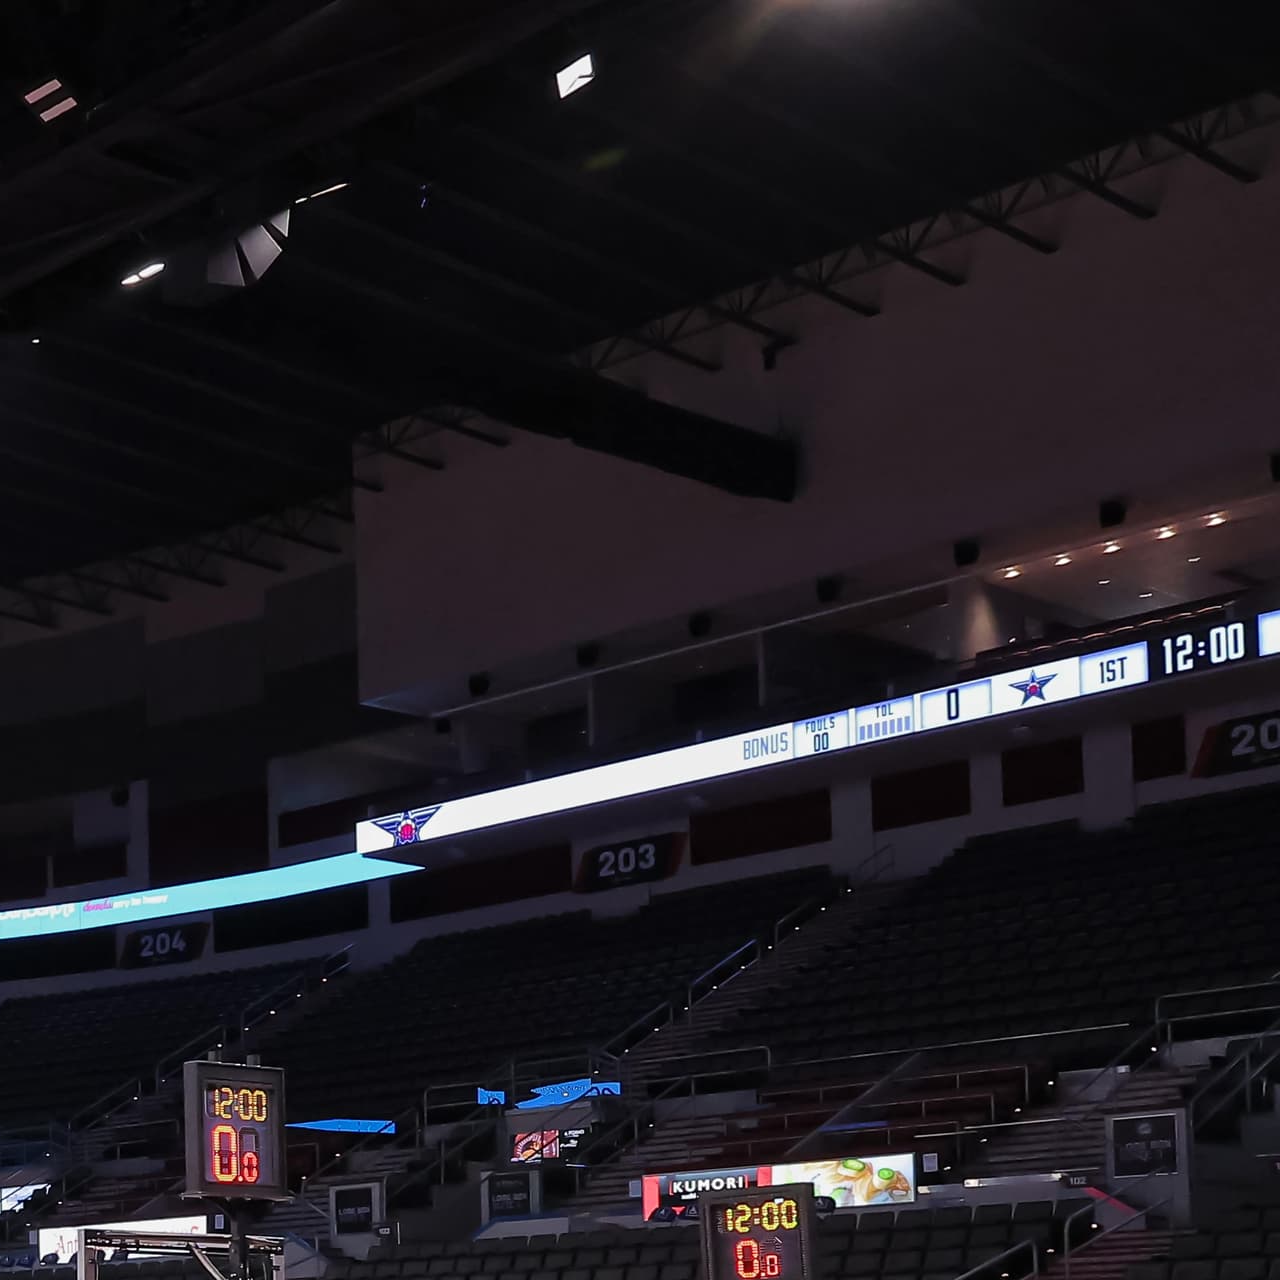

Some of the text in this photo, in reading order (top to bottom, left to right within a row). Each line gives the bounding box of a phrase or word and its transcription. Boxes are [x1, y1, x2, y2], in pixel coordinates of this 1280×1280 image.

[1163, 622, 1244, 675] 12:00
[1098, 655, 1128, 685] 1ST
[875, 703, 894, 718] TOL
[947, 688, 960, 721] 0
[805, 716, 836, 734] FOULS
[1231, 720, 1280, 758] 20
[743, 731, 789, 761] BONUS
[813, 732, 829, 753] 00
[598, 841, 657, 874] 203
[141, 930, 186, 957] 204
[208, 1086, 268, 1122] 12:00
[673, 1176, 744, 1194] KUMORI
[726, 1199, 799, 1233] 12:00
